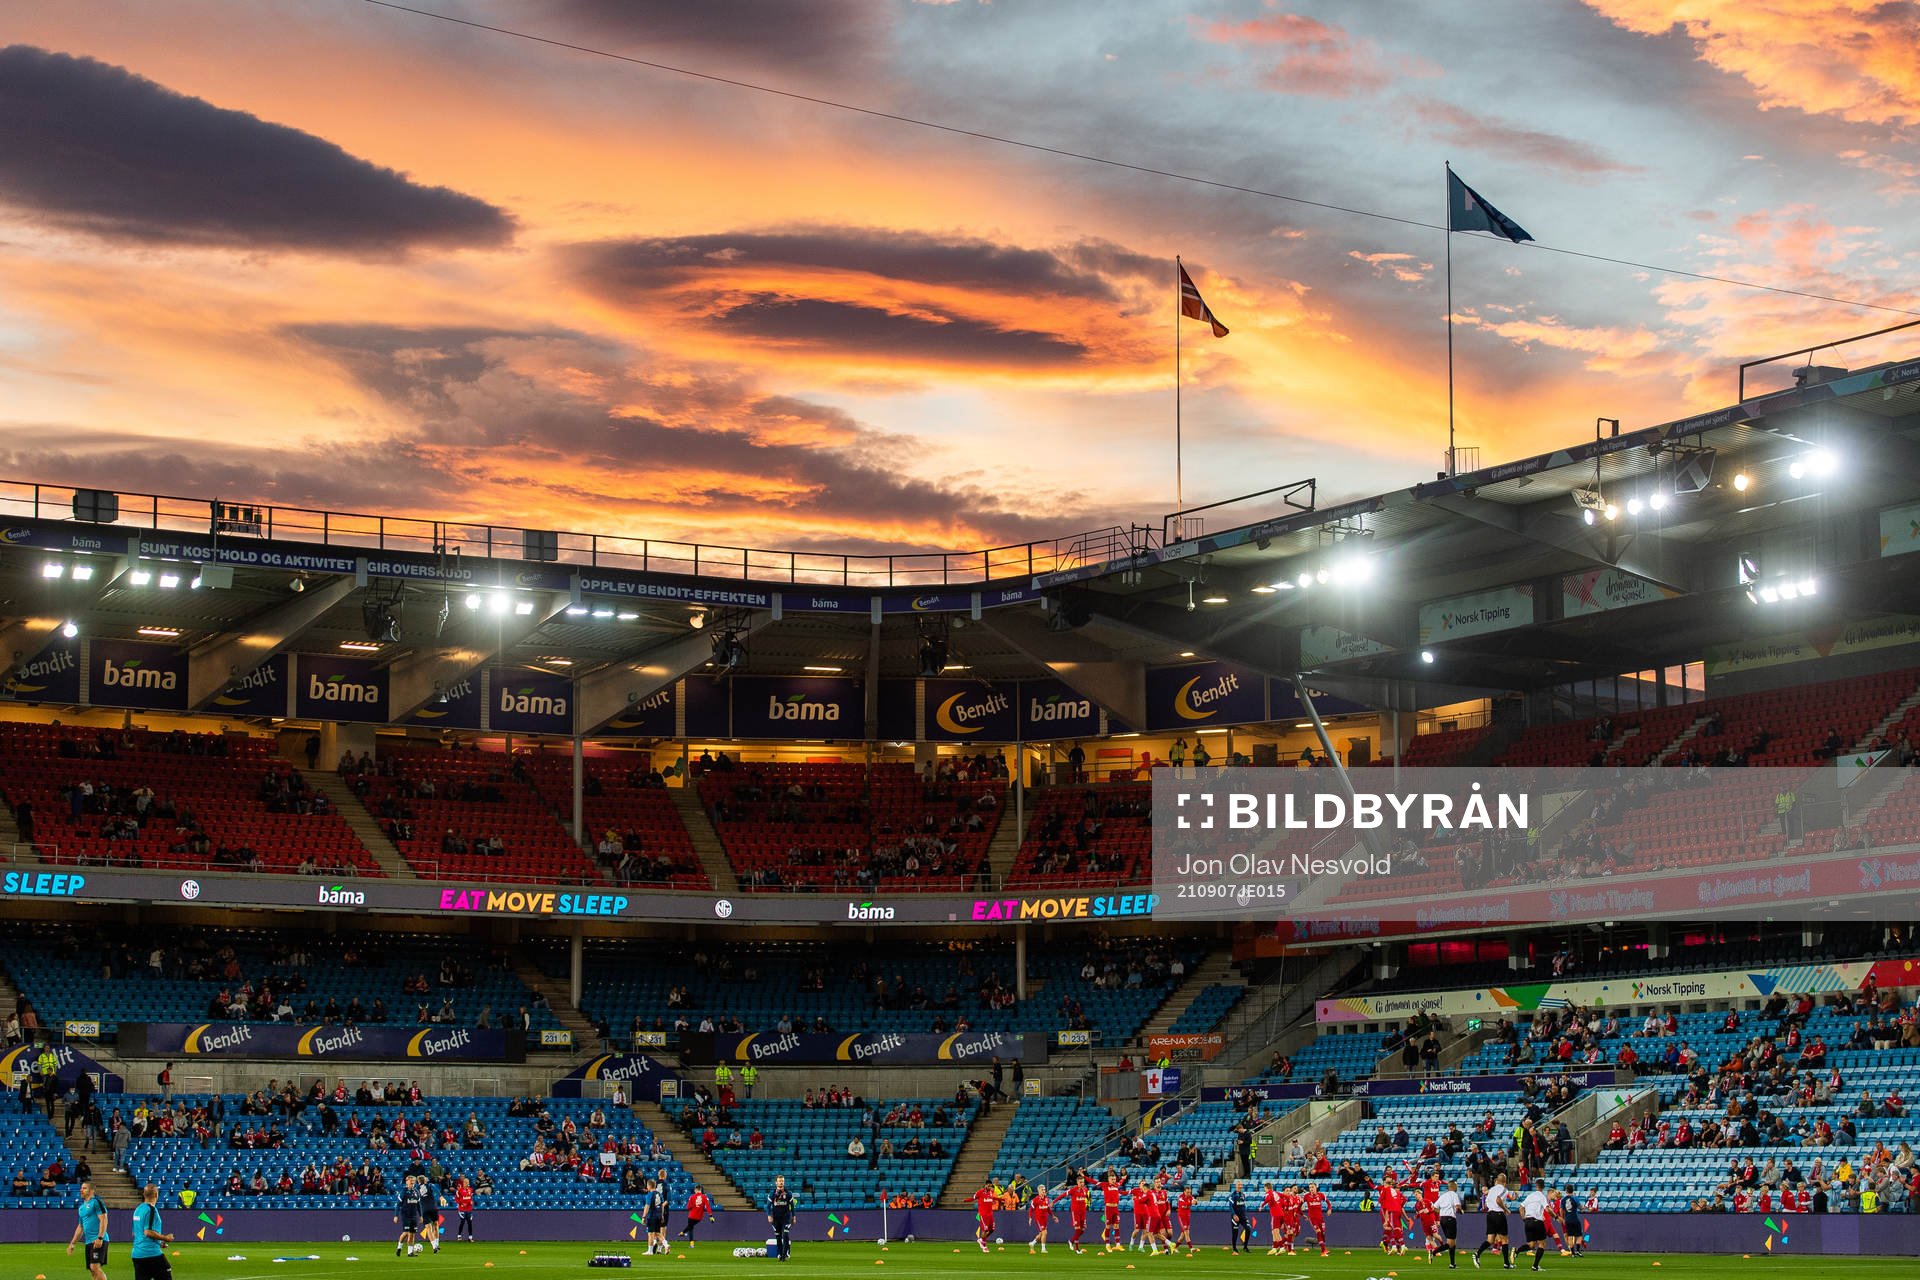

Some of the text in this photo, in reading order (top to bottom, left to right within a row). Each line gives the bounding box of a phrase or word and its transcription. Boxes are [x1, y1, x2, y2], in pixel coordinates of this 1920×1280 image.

[141, 542, 179, 556] SUNT
[261, 553, 281, 565] OG
[284, 555, 354, 570] AKTIVITET
[367, 561, 472, 580] GIR OVERSKUDD
[580, 579, 766, 605] OPPLEV BENDIT-EFFEKTEN
[1455, 605, 1511, 625] Norsk Tipping
[1191, 673, 1240, 708] Bendit
[955, 693, 1009, 723] Bendit
[3, 871, 86, 896] SLEEP
[439, 889, 628, 916] EAT MOVE SLEEP
[972, 893, 1160, 921] EAT MOVE SLEEP
[1646, 980, 1706, 997] Norsk Tipping
[80, 1025, 96, 1034] 229
[203, 1024, 252, 1053] Bendit
[315, 1026, 363, 1055] Bendit
[424, 1028, 471, 1056] Bendit
[545, 1034, 558, 1043] 231
[1071, 1034, 1086, 1043] 233
[1150, 1036, 1186, 1046] ARENA
[752, 1032, 801, 1060] Bendit
[853, 1032, 903, 1060] Bendit
[955, 1030, 1003, 1059] Bendit
[602, 1055, 651, 1082] Bendit
[1429, 1080, 1471, 1092] Norsk Tipping
